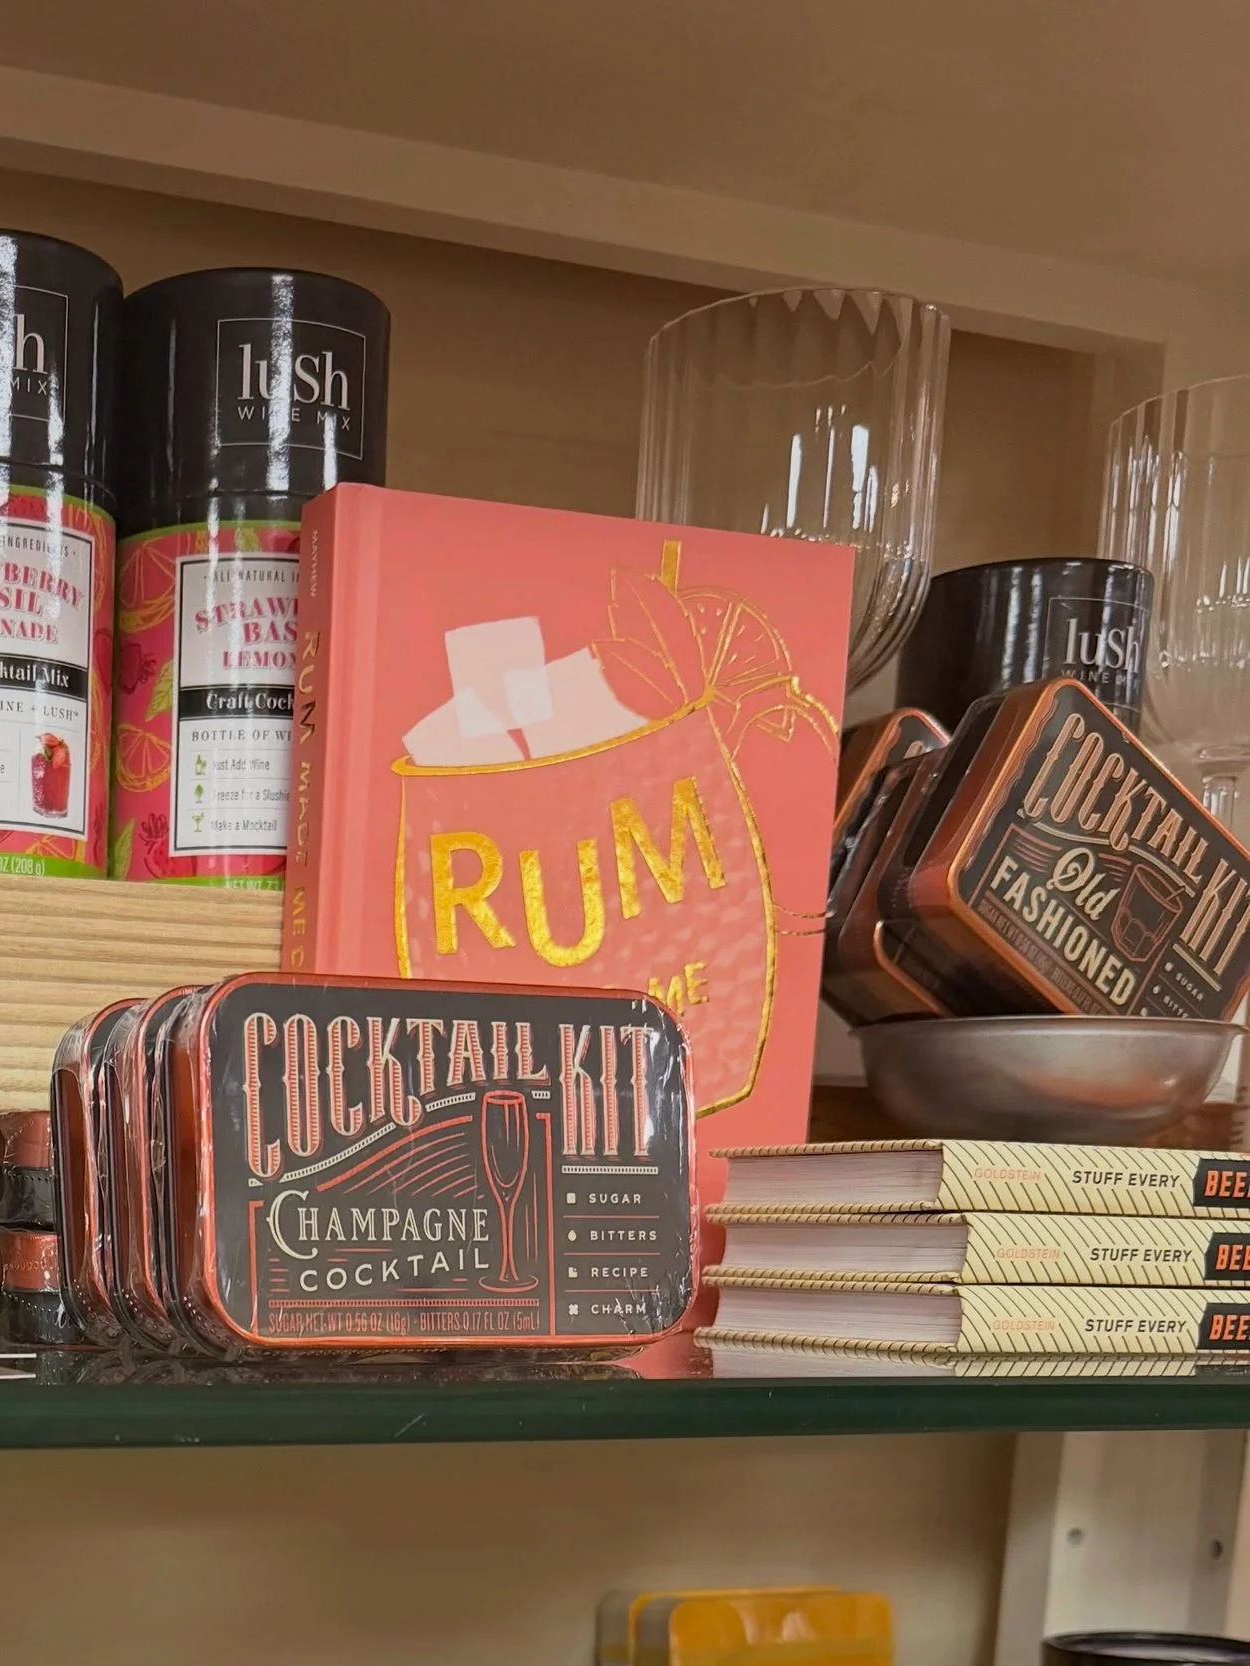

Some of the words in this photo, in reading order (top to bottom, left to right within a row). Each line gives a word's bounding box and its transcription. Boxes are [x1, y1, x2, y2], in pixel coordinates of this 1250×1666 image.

[6, 375, 49, 396] MIX
[309, 529, 318, 598] MAYHEW
[42, 667, 69, 688] Mix
[298, 631, 321, 746] RUM
[296, 762, 312, 867] MADE
[1022, 712, 1210, 883] COCKTAIL
[430, 776, 726, 968] RUM
[1048, 846, 1121, 922] Old
[291, 886, 306, 937] ME
[989, 856, 1136, 1007] FASHIONED
[243, 1011, 549, 1182] COCKTAIL
[558, 1022, 654, 1158] KIT
[588, 1191, 643, 1206] SUGAR
[974, 1168, 1042, 1183] GOLDSTEIN
[1071, 1170, 1125, 1188] STUFF
[1128, 1171, 1180, 1189] EVERY
[266, 1189, 491, 1260] CHAMPAGNE
[590, 1229, 658, 1243] BITTERS
[300, 1251, 490, 1293] COCKTAIL
[590, 1267, 649, 1279] RECIPE
[1089, 1247, 1139, 1262] STUFF
[1142, 1248, 1193, 1264] EVERY
[590, 1302, 647, 1316] CHARM
